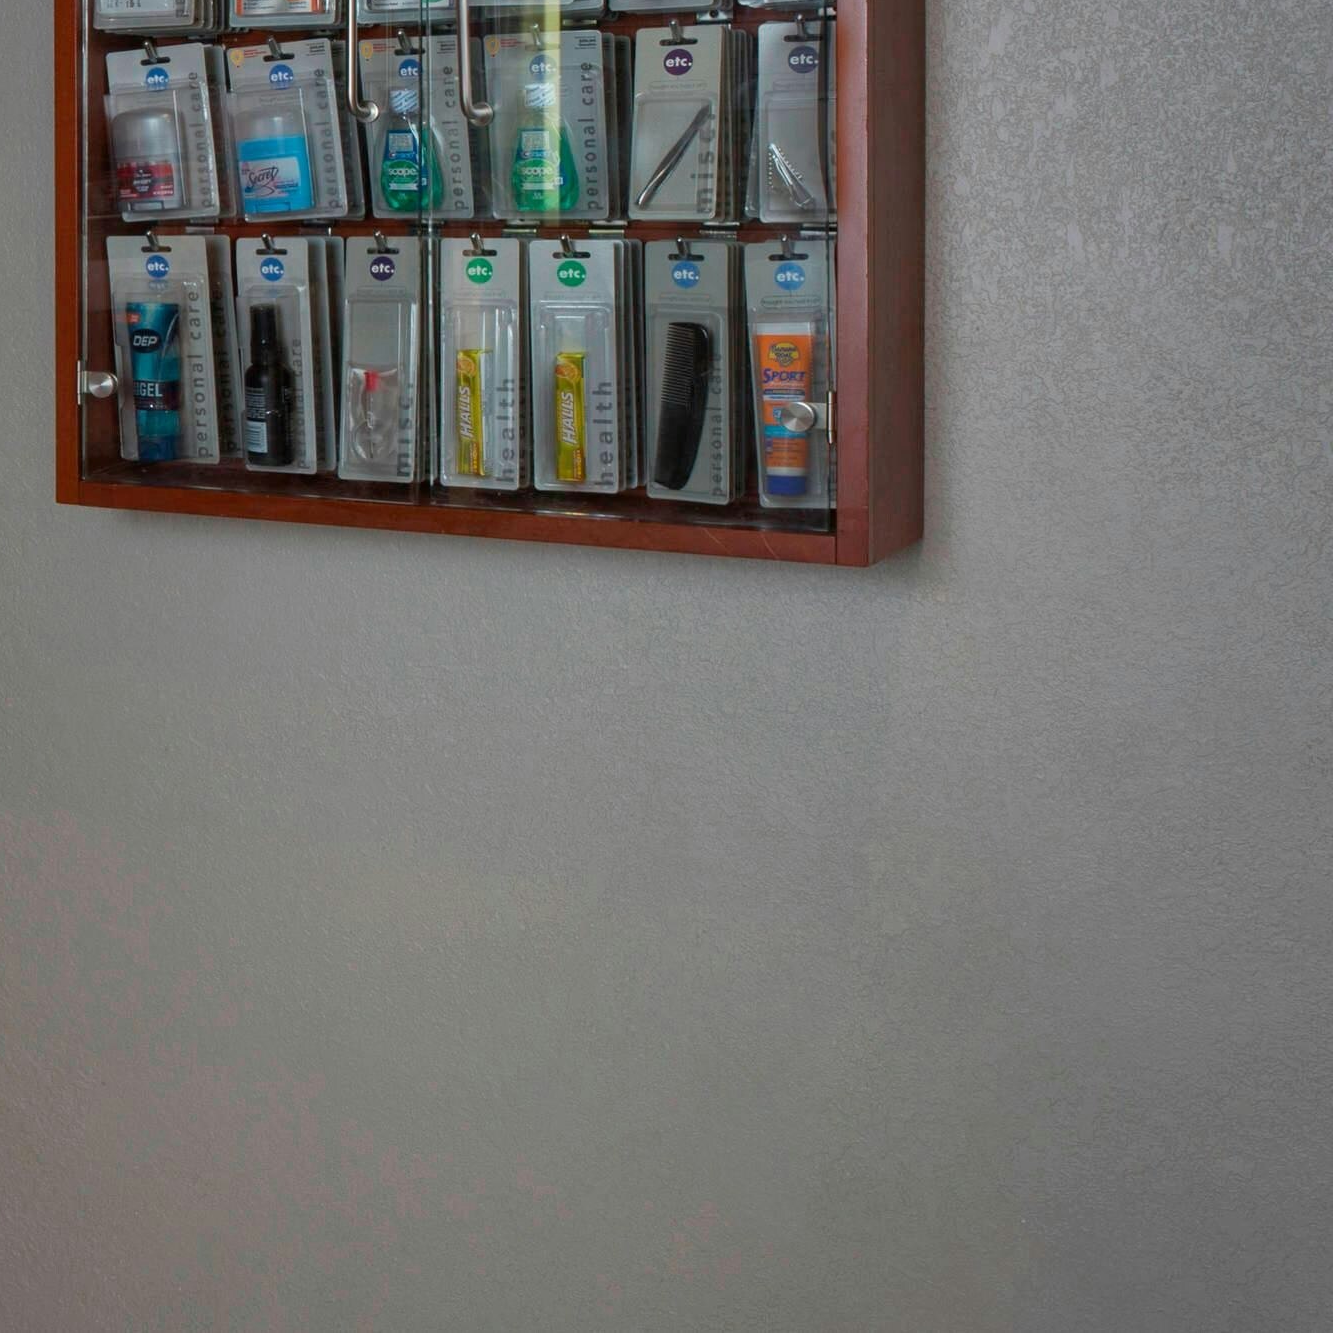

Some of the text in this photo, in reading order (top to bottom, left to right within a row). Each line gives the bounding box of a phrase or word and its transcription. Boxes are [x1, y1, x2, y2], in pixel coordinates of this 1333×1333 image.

[664, 55, 692, 67] etc.
[558, 268, 586, 280] etc.
[132, 334, 158, 347] DEP
[763, 368, 805, 384] SPORT
[460, 385, 476, 438] HALLS
[562, 391, 576, 445] HALLS
